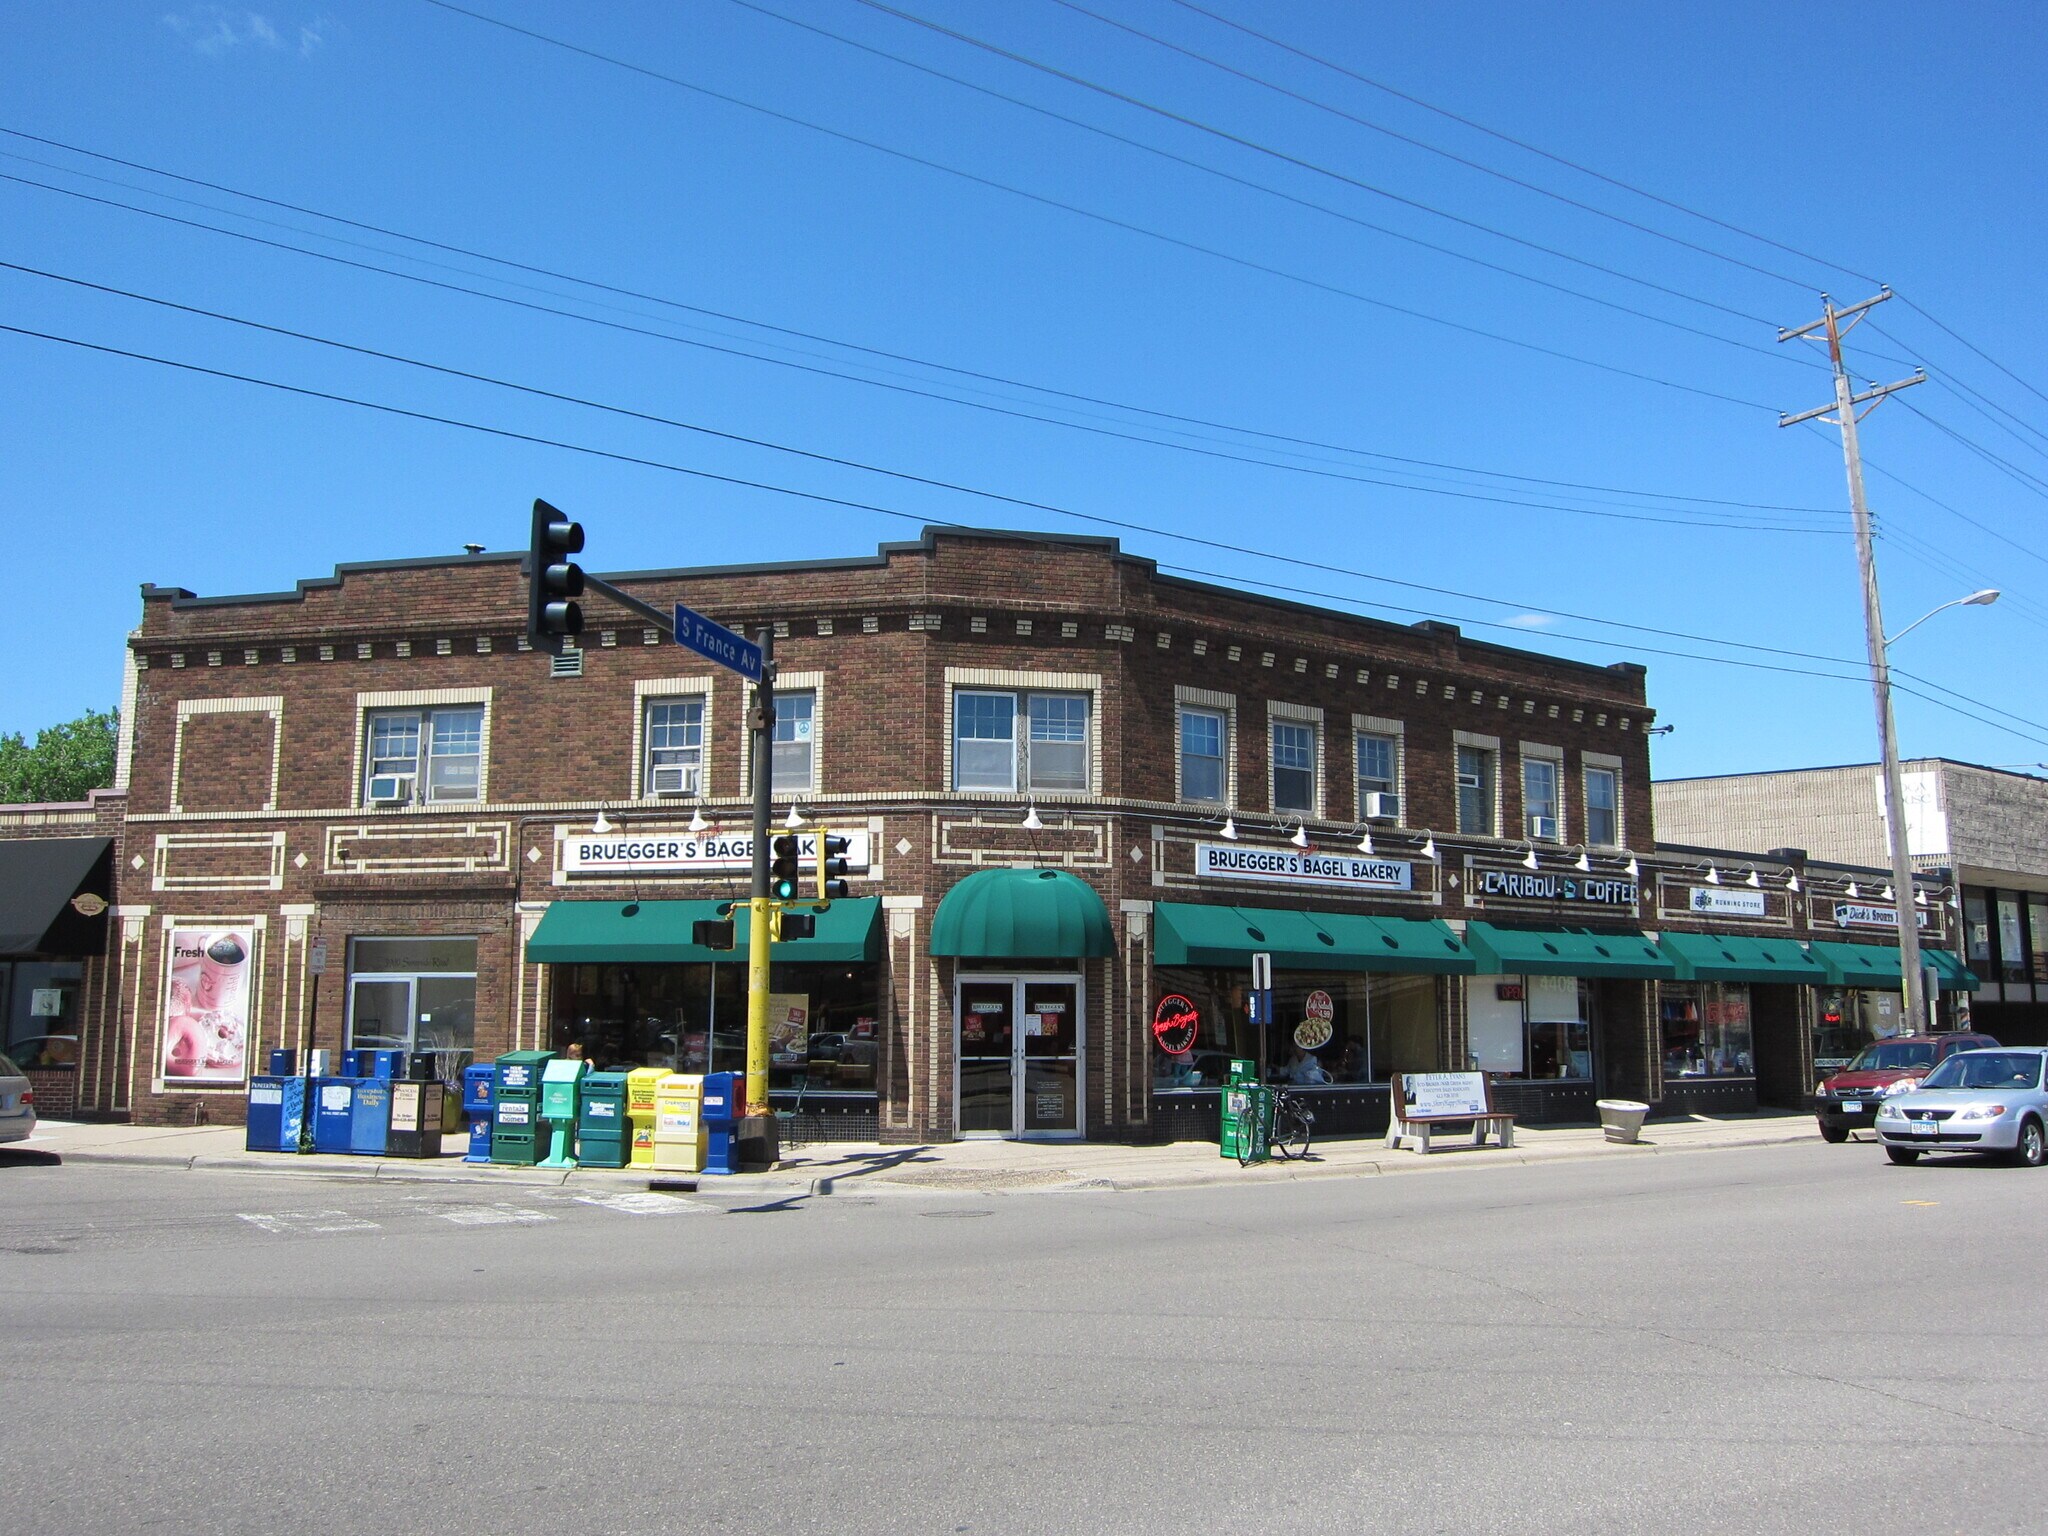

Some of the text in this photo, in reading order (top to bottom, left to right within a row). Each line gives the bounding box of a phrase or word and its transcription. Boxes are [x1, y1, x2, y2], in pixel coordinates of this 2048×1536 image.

[682, 617, 755, 671] S France Av
[580, 839, 753, 860] BRUEGGER'S BAGE
[1208, 850, 1298, 873] BRUEGGER'S
[1304, 858, 1346, 877] BAGEL
[1352, 860, 1401, 880] BAKERY
[1484, 871, 1639, 904] CARIBOU COFFEE
[1715, 899, 1741, 907] RUNNING
[1850, 907, 1871, 920] Dick's
[174, 946, 204, 958] Fresh
[1502, 986, 1524, 998] OPEN
[501, 1104, 526, 1112] rentals
[502, 1114, 526, 1123] homes
